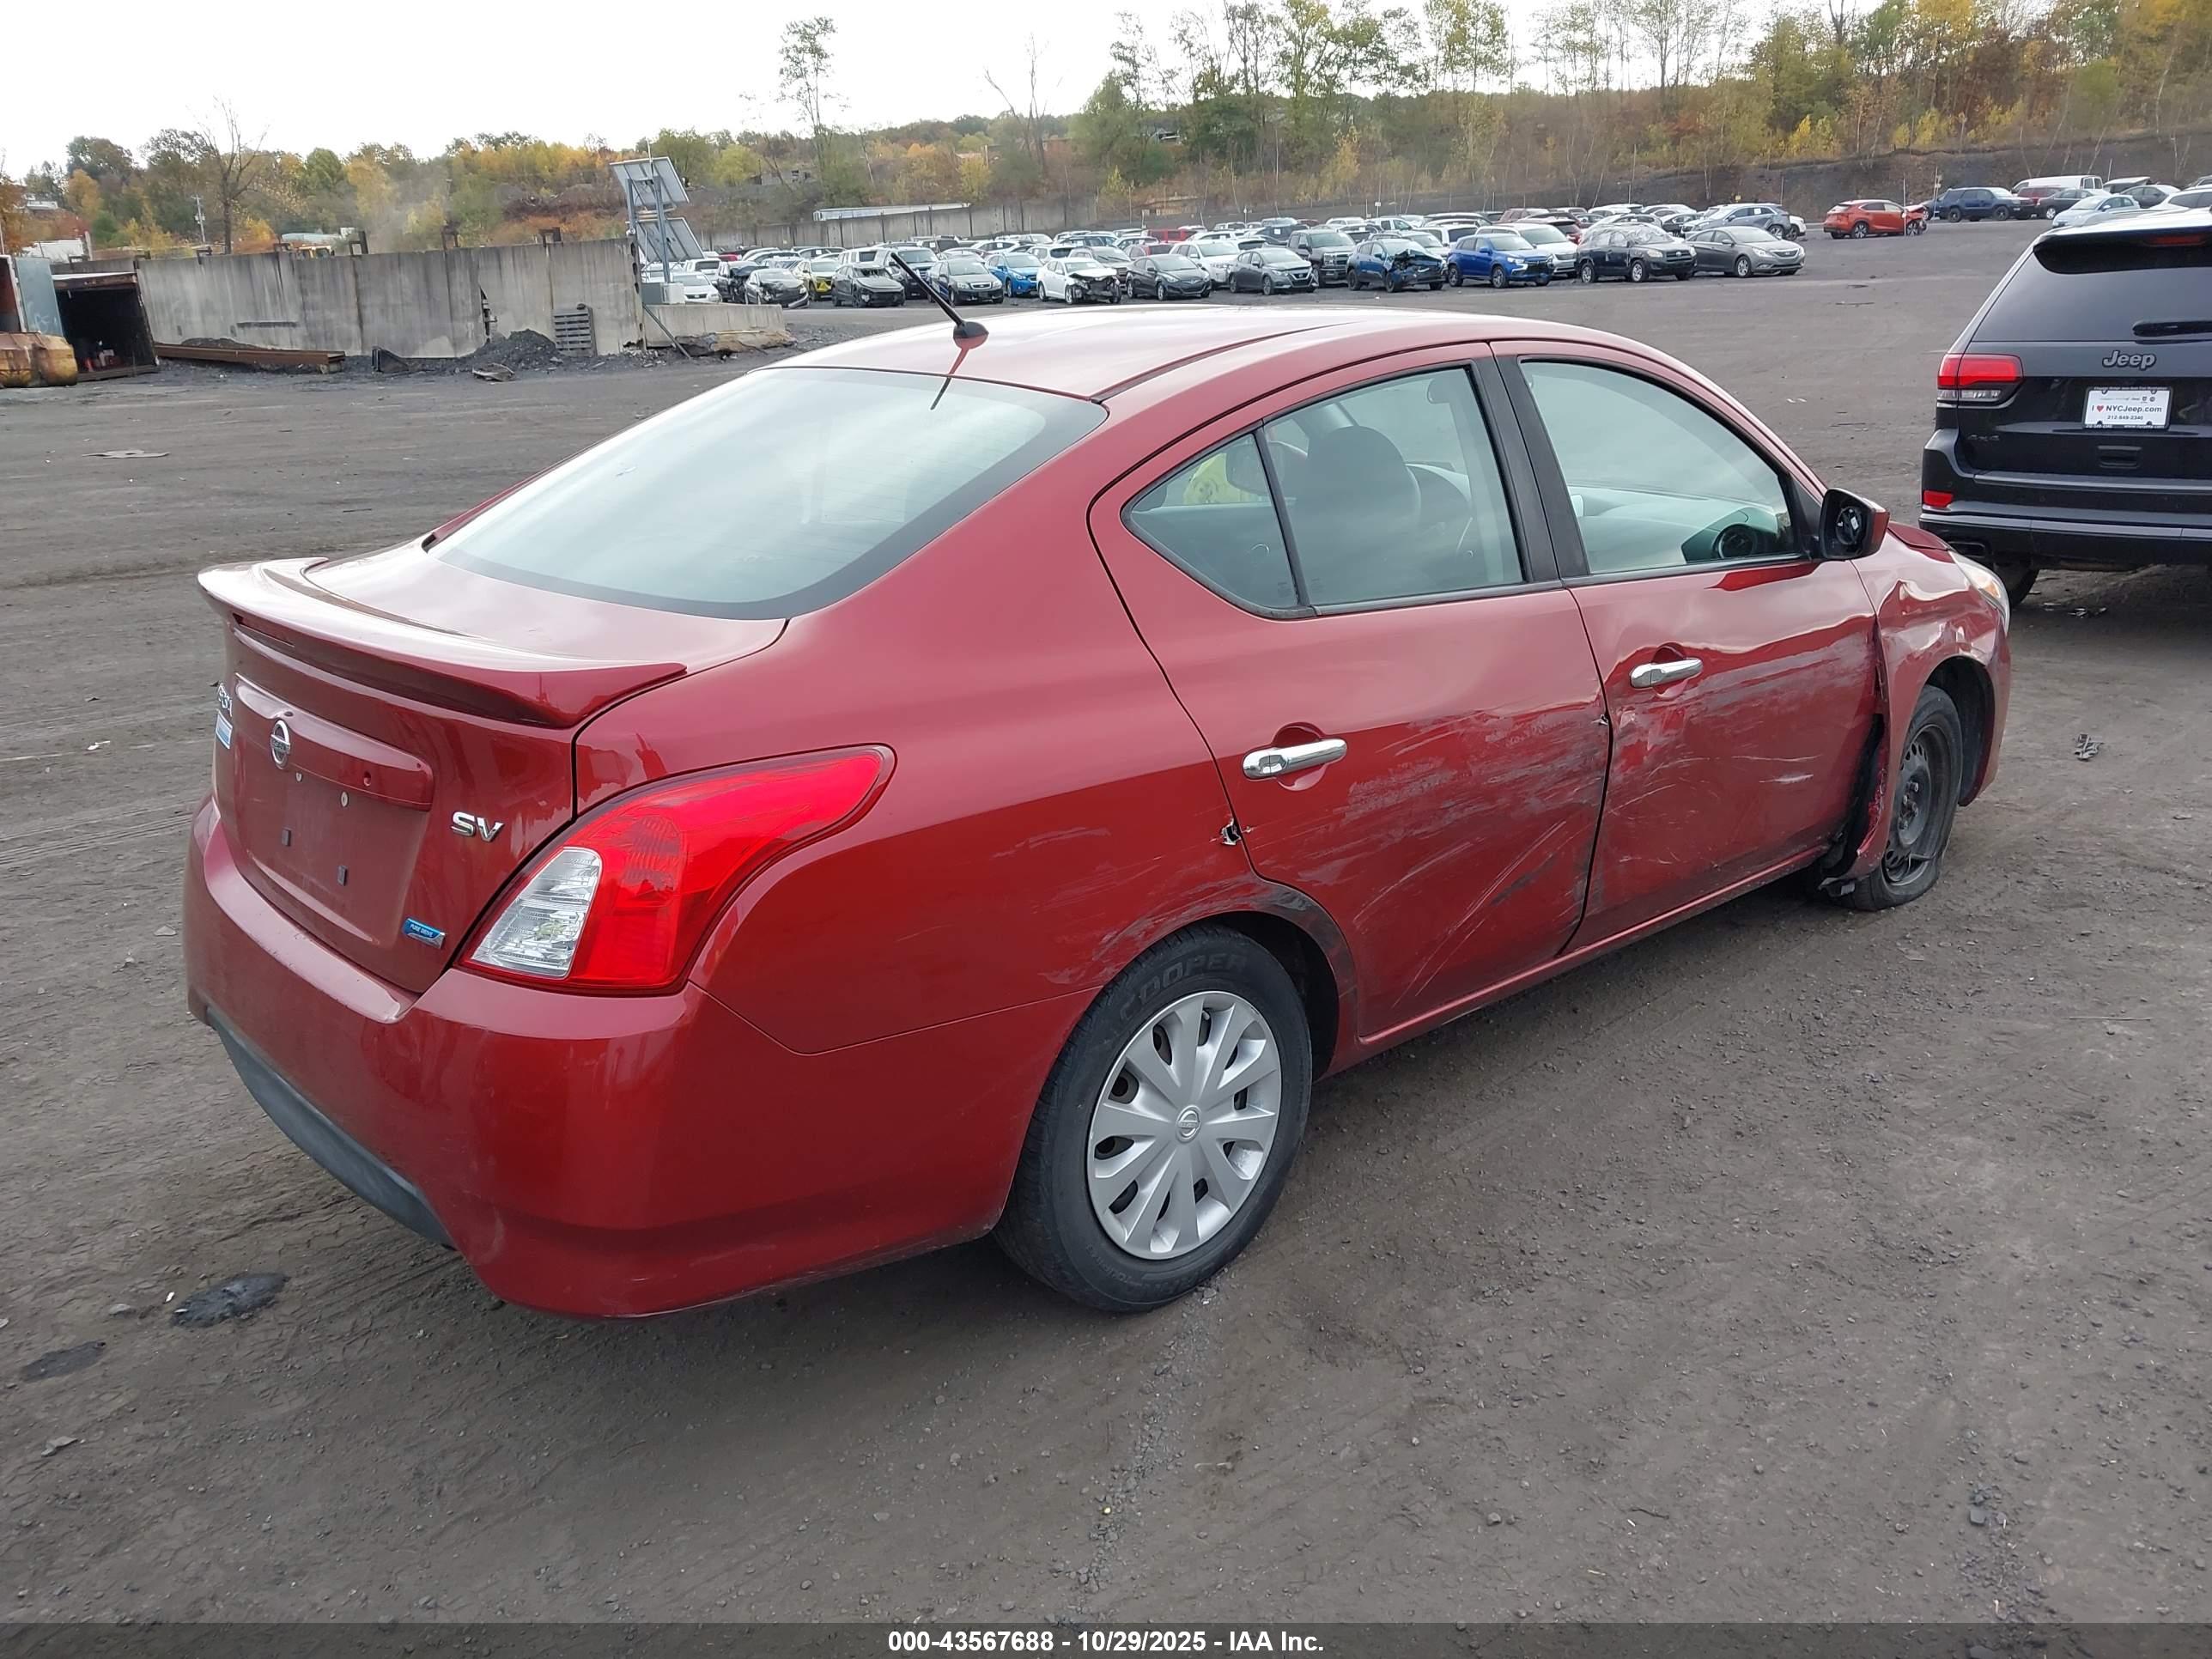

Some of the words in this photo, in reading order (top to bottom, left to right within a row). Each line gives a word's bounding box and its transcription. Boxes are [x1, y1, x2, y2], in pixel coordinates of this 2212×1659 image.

[2103, 350, 2156, 370] Jeep
[2106, 404, 2162, 413] NYCJeep.com
[450, 811, 505, 842] SV
